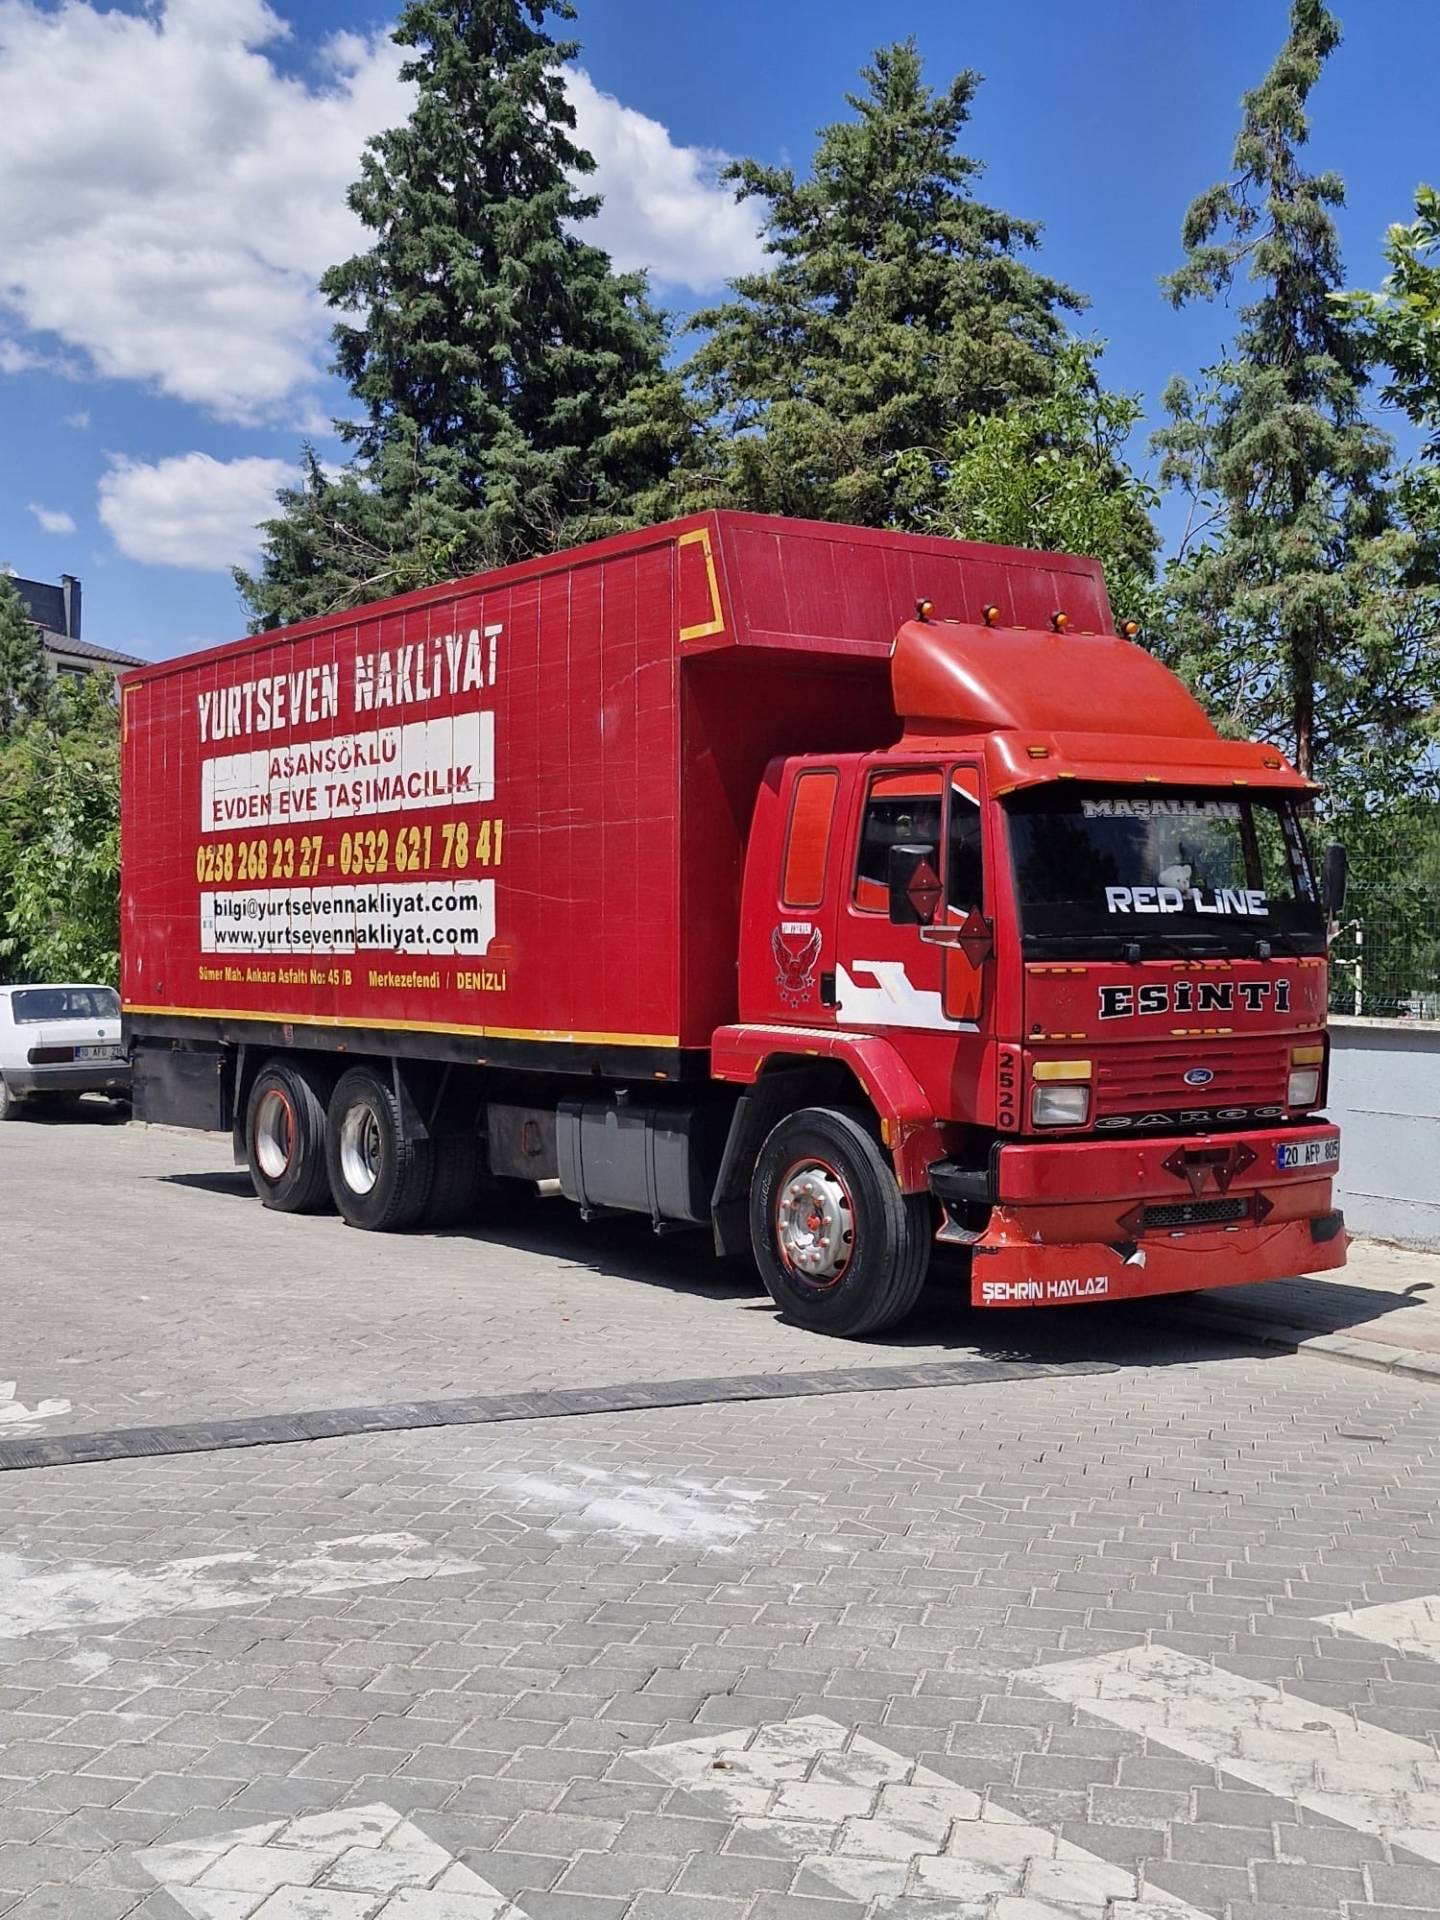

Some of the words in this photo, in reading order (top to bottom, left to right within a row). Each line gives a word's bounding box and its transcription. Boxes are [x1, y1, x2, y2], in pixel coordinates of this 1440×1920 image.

[198, 662, 339, 743] YURTSEVEN
[270, 732, 396, 779] ASANSÖRLÜ
[213, 793, 271, 822] EVDEN
[280, 787, 317, 814] EVE
[325, 765, 473, 812] TAŞIMACILIK
[1081, 800, 1242, 820] MAŞALLAH
[196, 842, 233, 883] 0258
[237, 840, 267, 880] 268
[272, 838, 294, 878] 23
[299, 836, 323, 877] 27
[340, 829, 388, 875] 0532
[395, 825, 431, 871] 621
[441, 822, 468, 868] 78
[476, 819, 503, 866] 41
[214, 892, 478, 921] bilgi@yurtsevennakliyat.com
[1105, 886, 1184, 913] RED
[215, 924, 479, 948] www.yurtsevennakliyat.com
[199, 966, 223, 981] Sümer
[225, 967, 244, 982] Mah.
[246, 967, 276, 983] Ankara
[310, 969, 326, 985] No:
[328, 969, 340, 985] 45
[368, 970, 440, 988] Merkezefendi
[456, 968, 506, 991] DENİZLİ
[999, 1052, 1015, 1128] 2520
[1095, 1107, 1283, 1128] CARGO
[1285, 1147, 1298, 1165] 20
[1305, 1143, 1320, 1163] AFP
[982, 1278, 1042, 1304] ŞEHRİN
[1047, 1276, 1108, 1298] HAYLAZI
